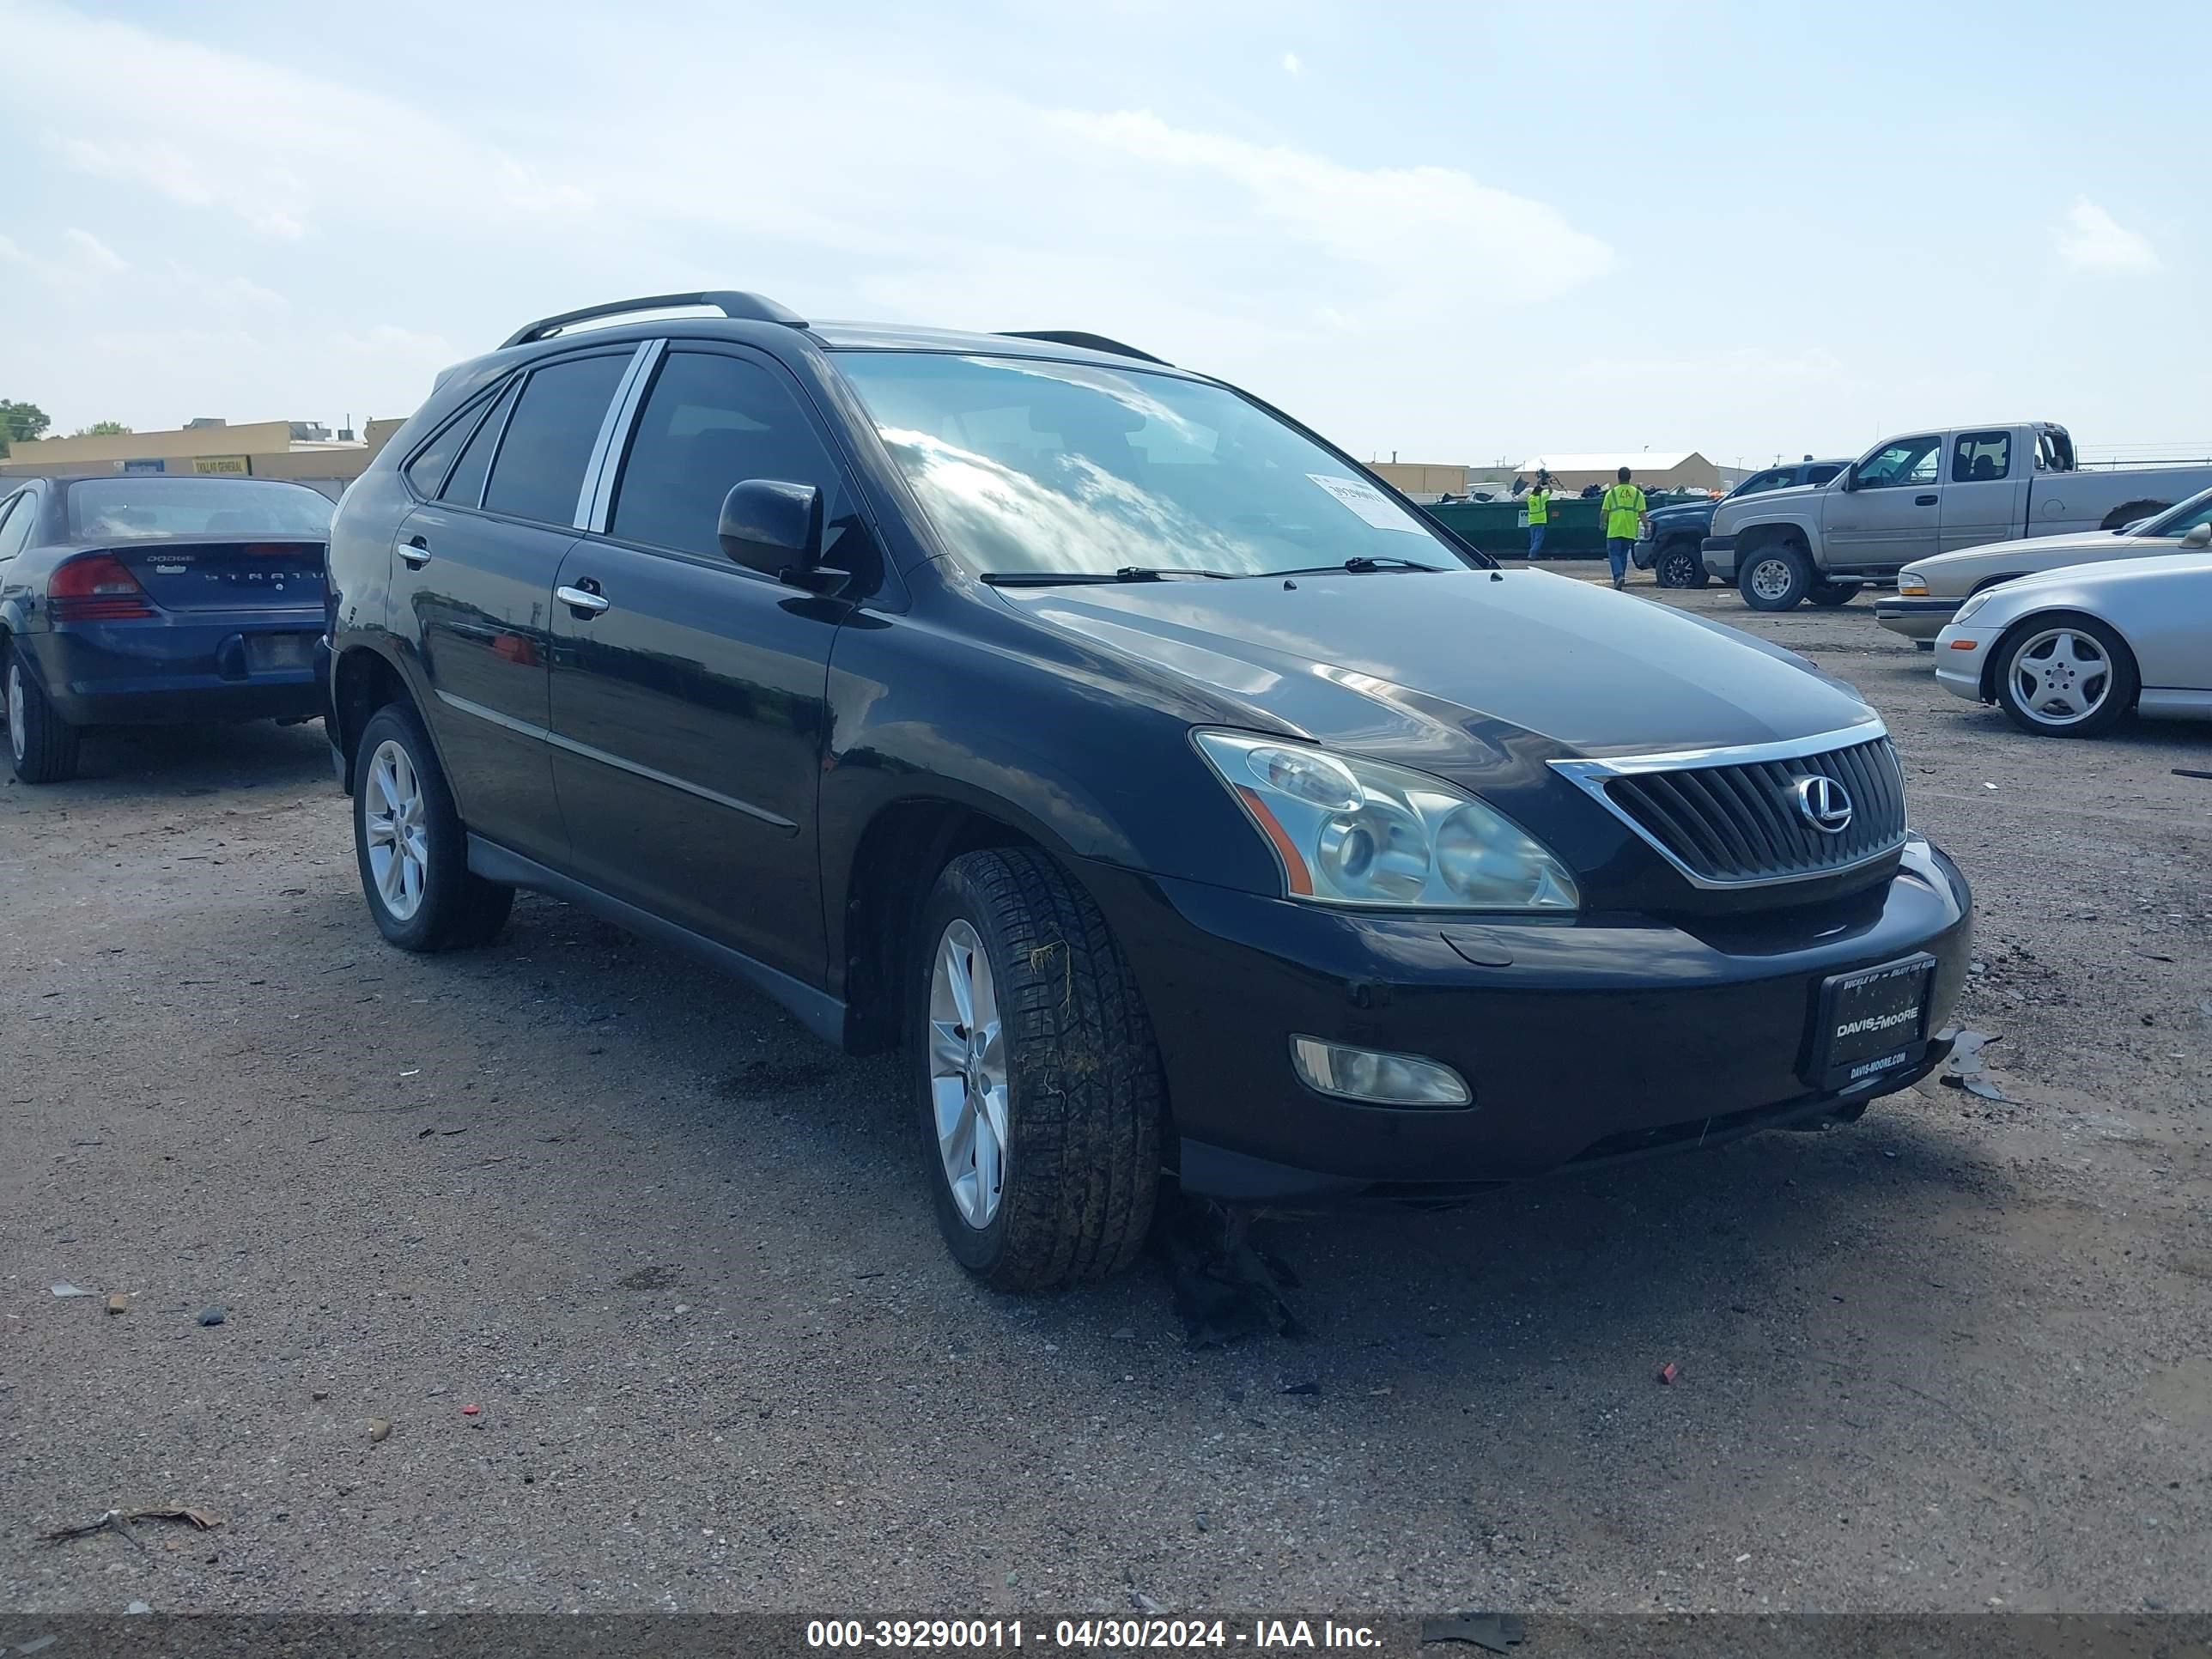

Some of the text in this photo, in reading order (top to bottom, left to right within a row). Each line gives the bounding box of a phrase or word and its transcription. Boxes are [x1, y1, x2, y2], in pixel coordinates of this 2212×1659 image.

[196, 460, 243, 474] DOLLAR GENERAL
[1844, 976, 1869, 990] BUCKLE
[1869, 974, 1880, 983] UP
[1850, 1051, 1906, 1079] DAVIS-MOORE.COM
